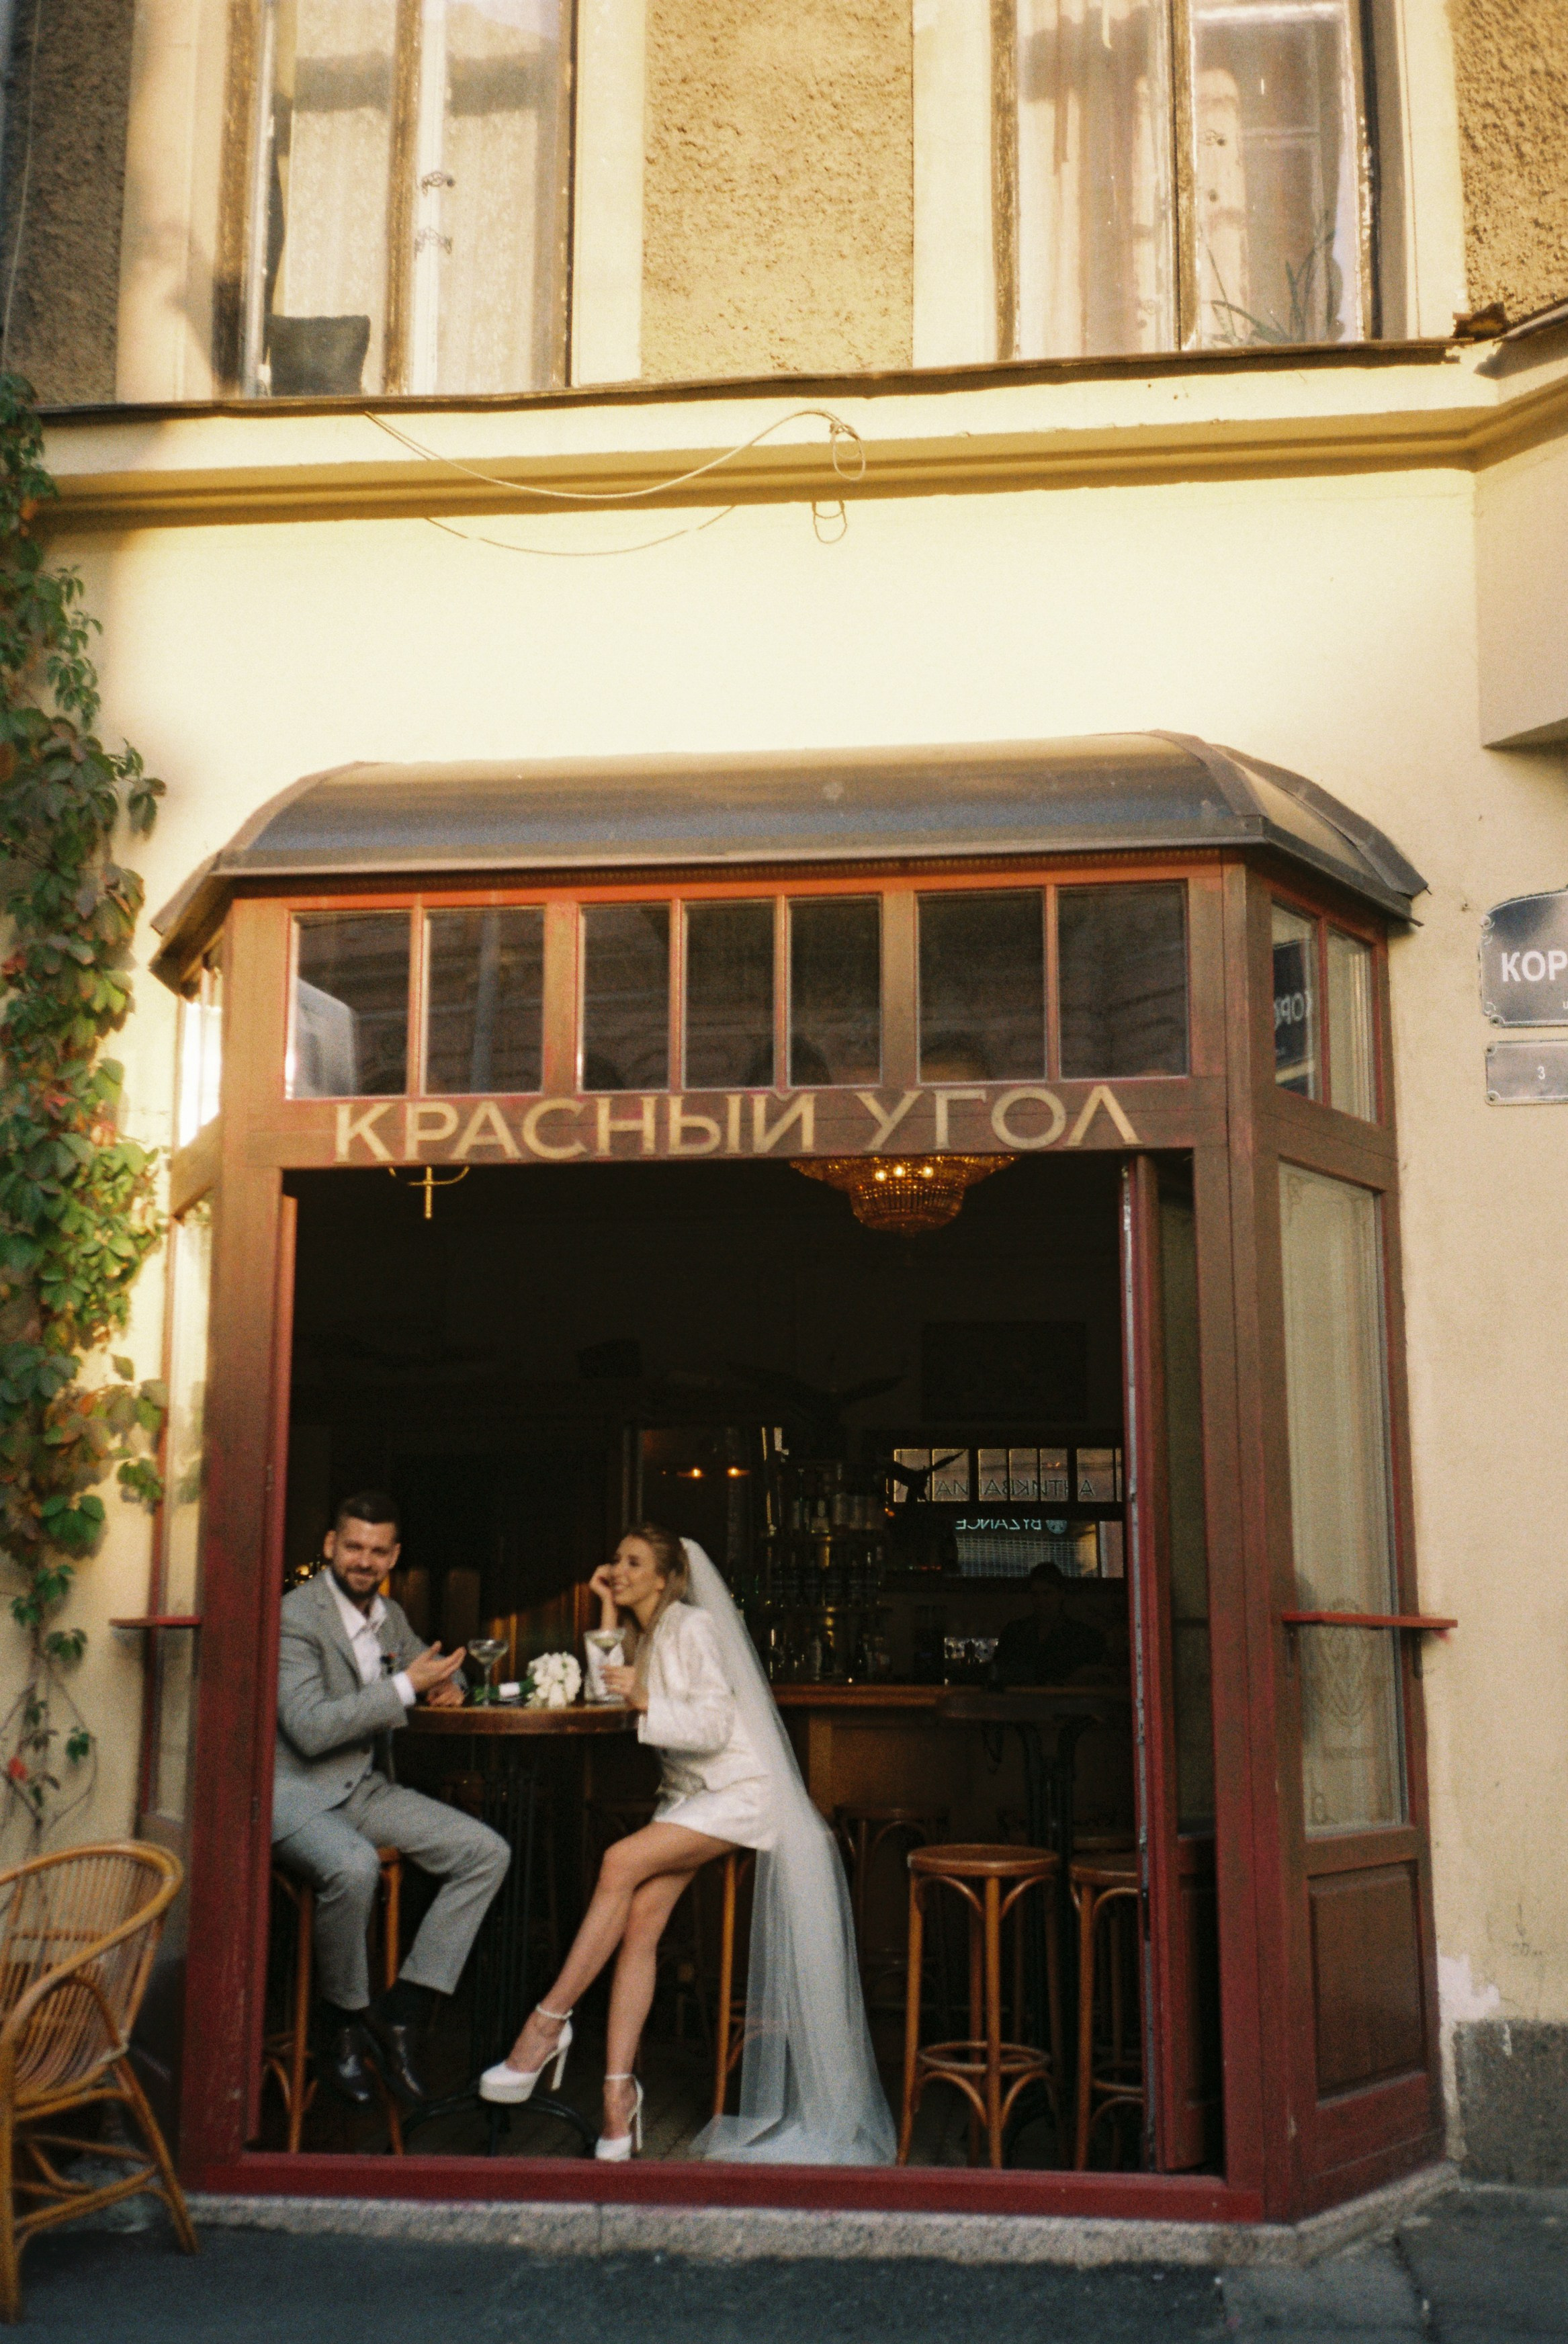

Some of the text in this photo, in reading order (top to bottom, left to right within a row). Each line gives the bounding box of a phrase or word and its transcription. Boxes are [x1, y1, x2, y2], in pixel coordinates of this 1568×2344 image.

[1501, 950, 1568, 982] КОР
[1537, 1066, 1546, 1080] 3
[335, 1085, 1142, 1162] КРАСНЫЙ УГОЛ
